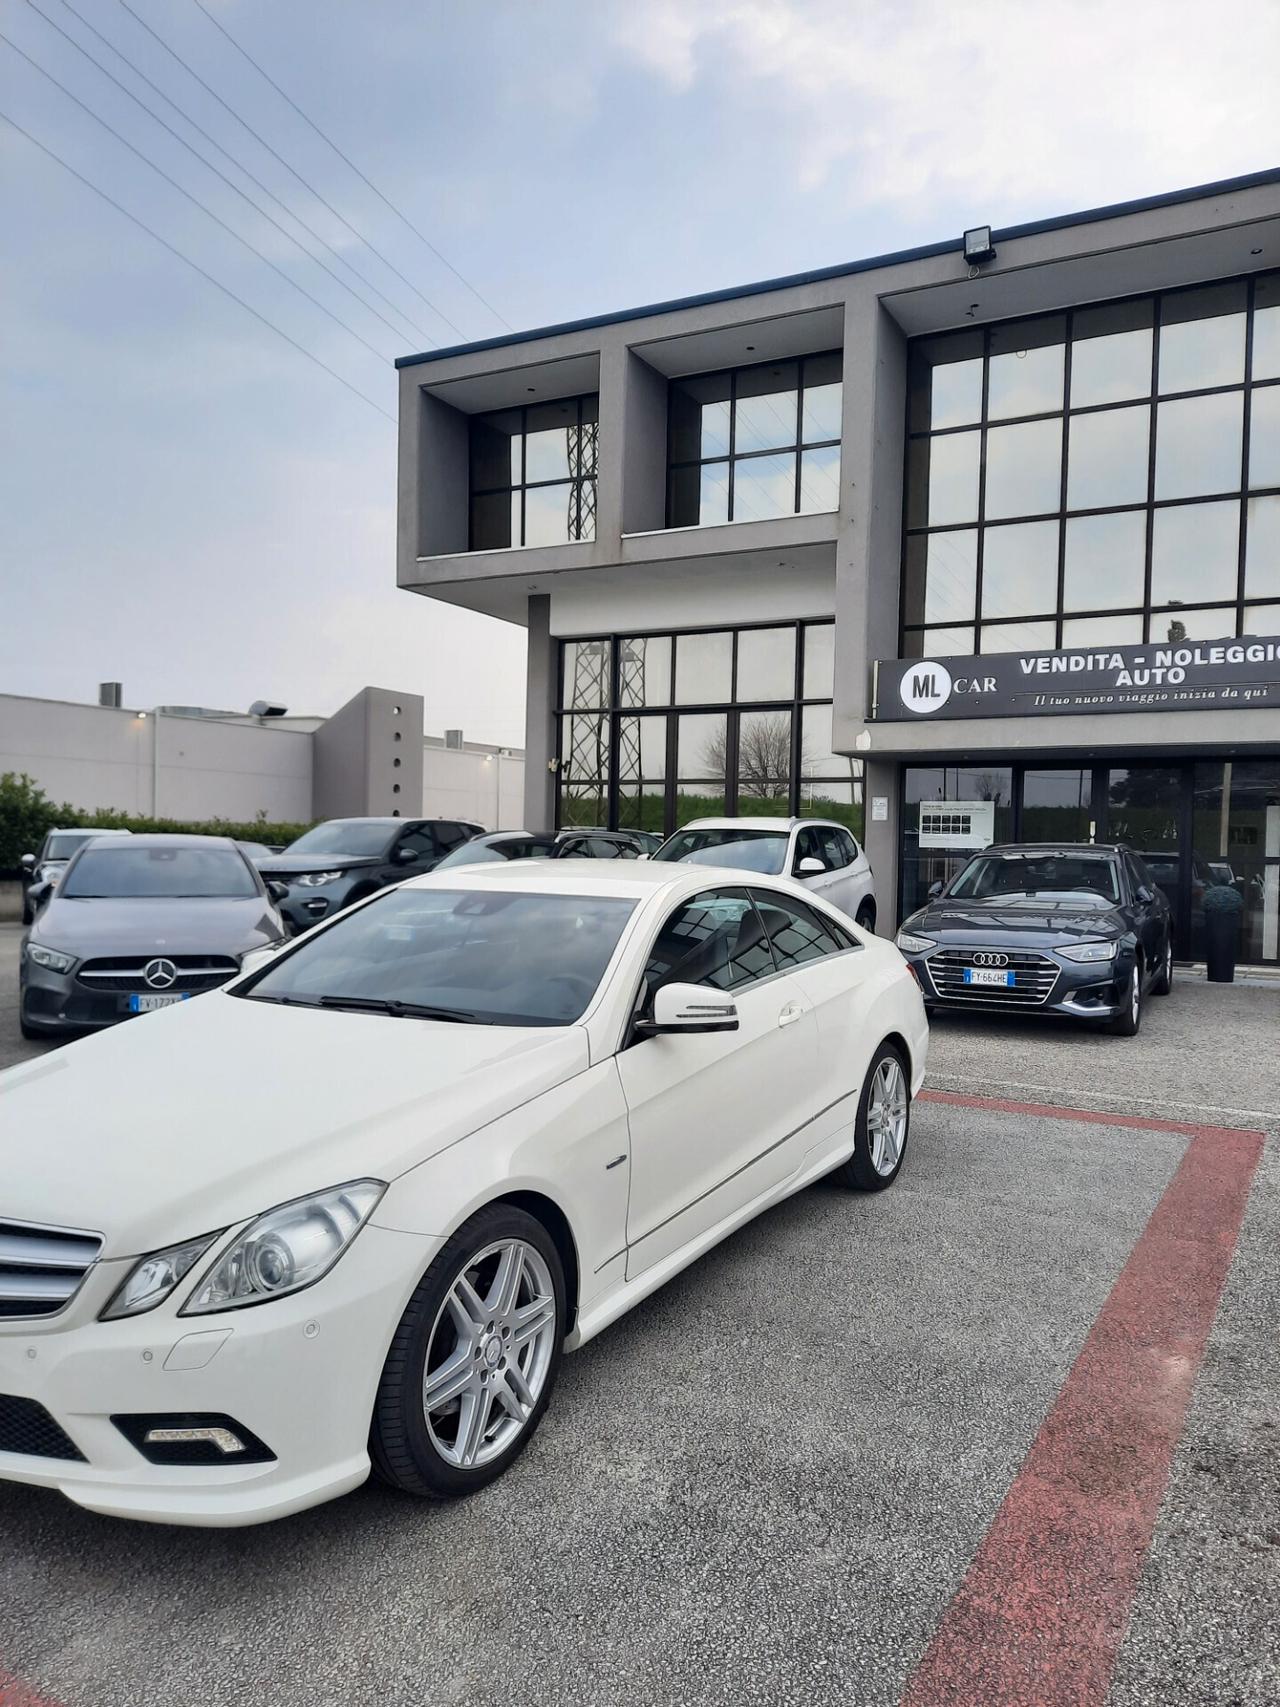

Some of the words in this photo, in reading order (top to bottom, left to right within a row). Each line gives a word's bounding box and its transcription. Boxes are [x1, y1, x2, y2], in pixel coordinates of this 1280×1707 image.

[1020, 653, 1125, 674] VENDITA
[1155, 644, 1280, 668] NOLEGGI
[912, 674, 941, 699] ML
[953, 677, 997, 694] CAR
[1115, 667, 1186, 687] AUTO
[1034, 695, 1046, 706] Il
[1050, 696, 1070, 705] tuo
[1075, 694, 1114, 704] nuovo
[1119, 690, 1168, 704] viaggio
[1174, 688, 1216, 700] inizia
[1221, 687, 1238, 698] da
[1244, 685, 1268, 700] qui
